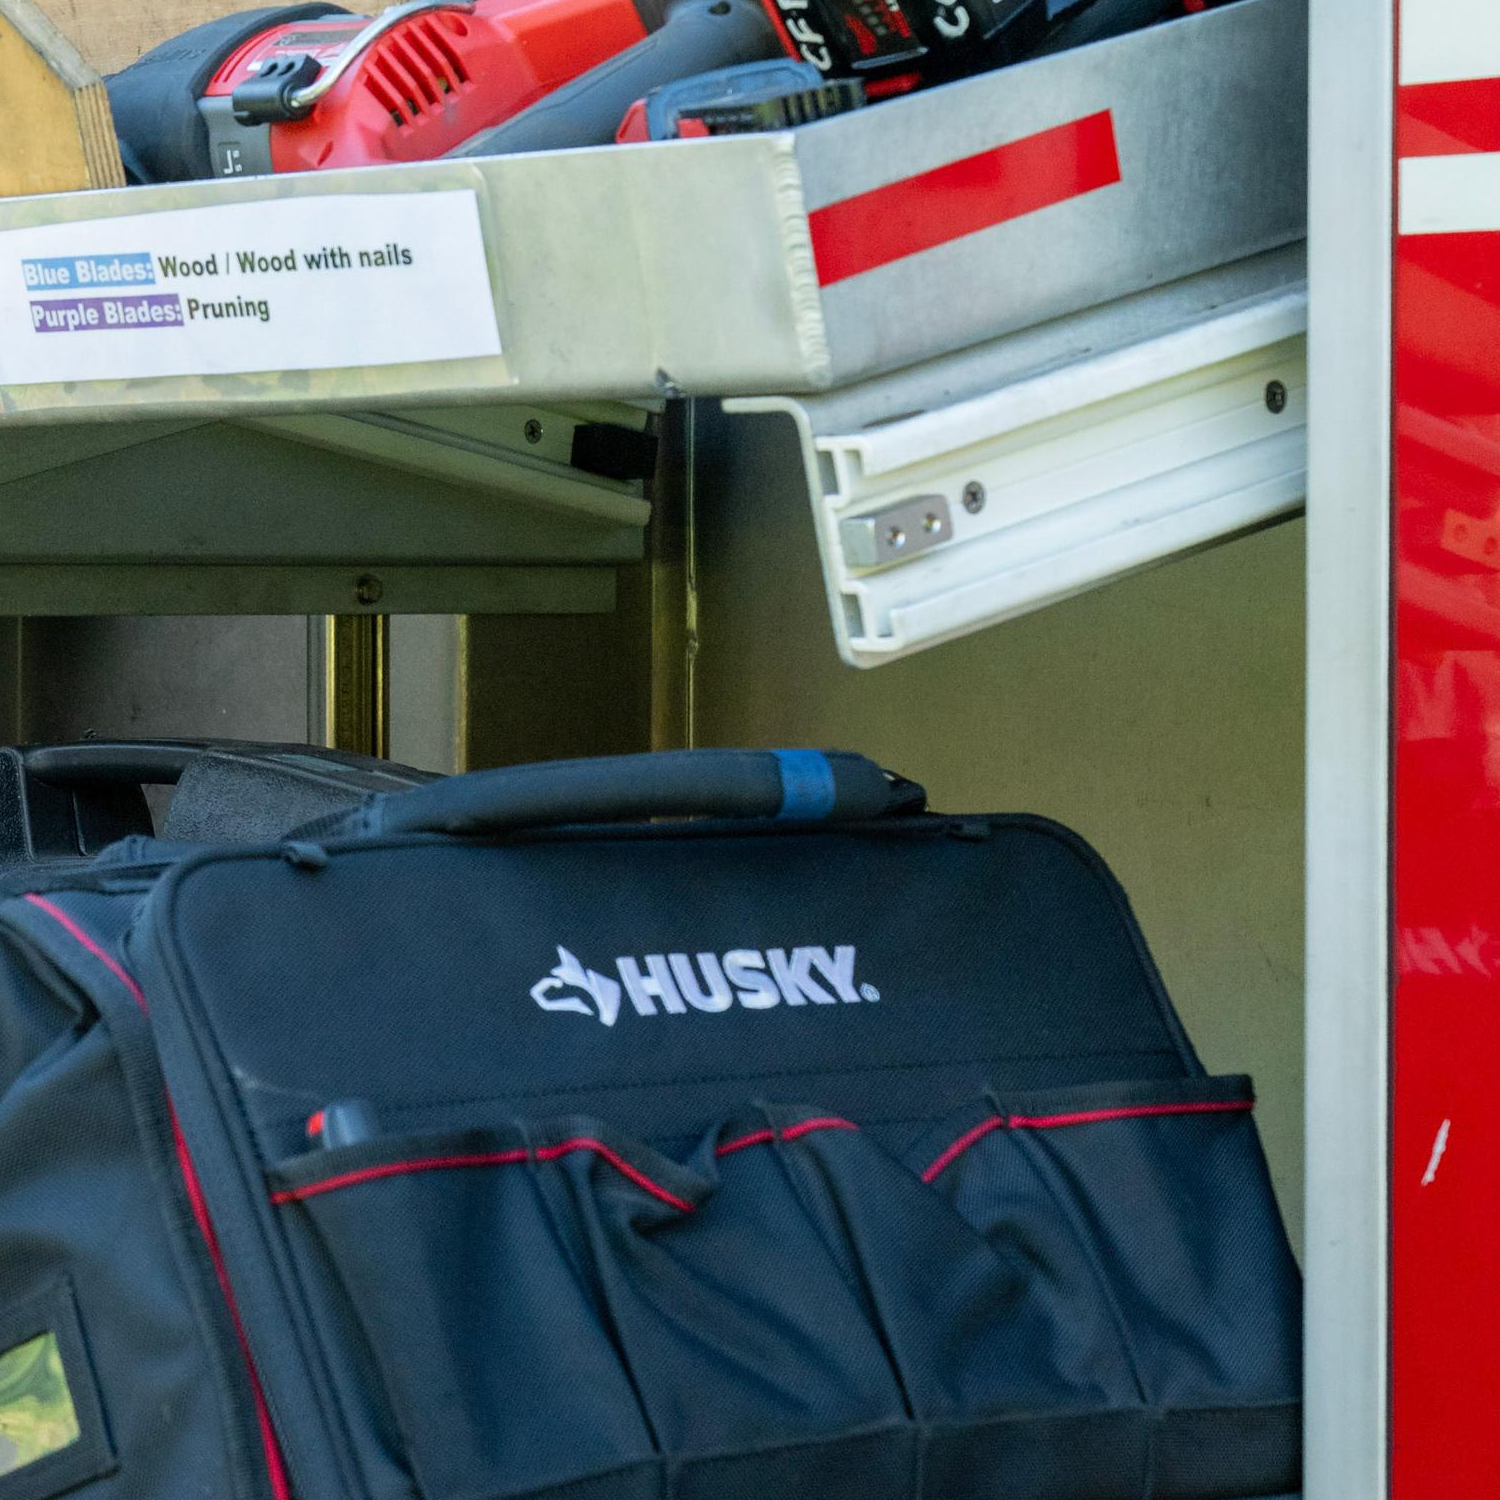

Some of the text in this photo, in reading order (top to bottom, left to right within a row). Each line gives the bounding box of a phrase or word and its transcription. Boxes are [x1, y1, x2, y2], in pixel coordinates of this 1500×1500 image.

[23, 261, 71, 287] Blue
[75, 259, 155, 284] Blades:
[157, 255, 219, 279] Wood
[236, 250, 298, 275] Wood
[303, 245, 352, 271] with
[358, 242, 414, 268] nails
[31, 296, 271, 332] Purple Blades: Pruning
[614, 944, 862, 1018] HUSKY
